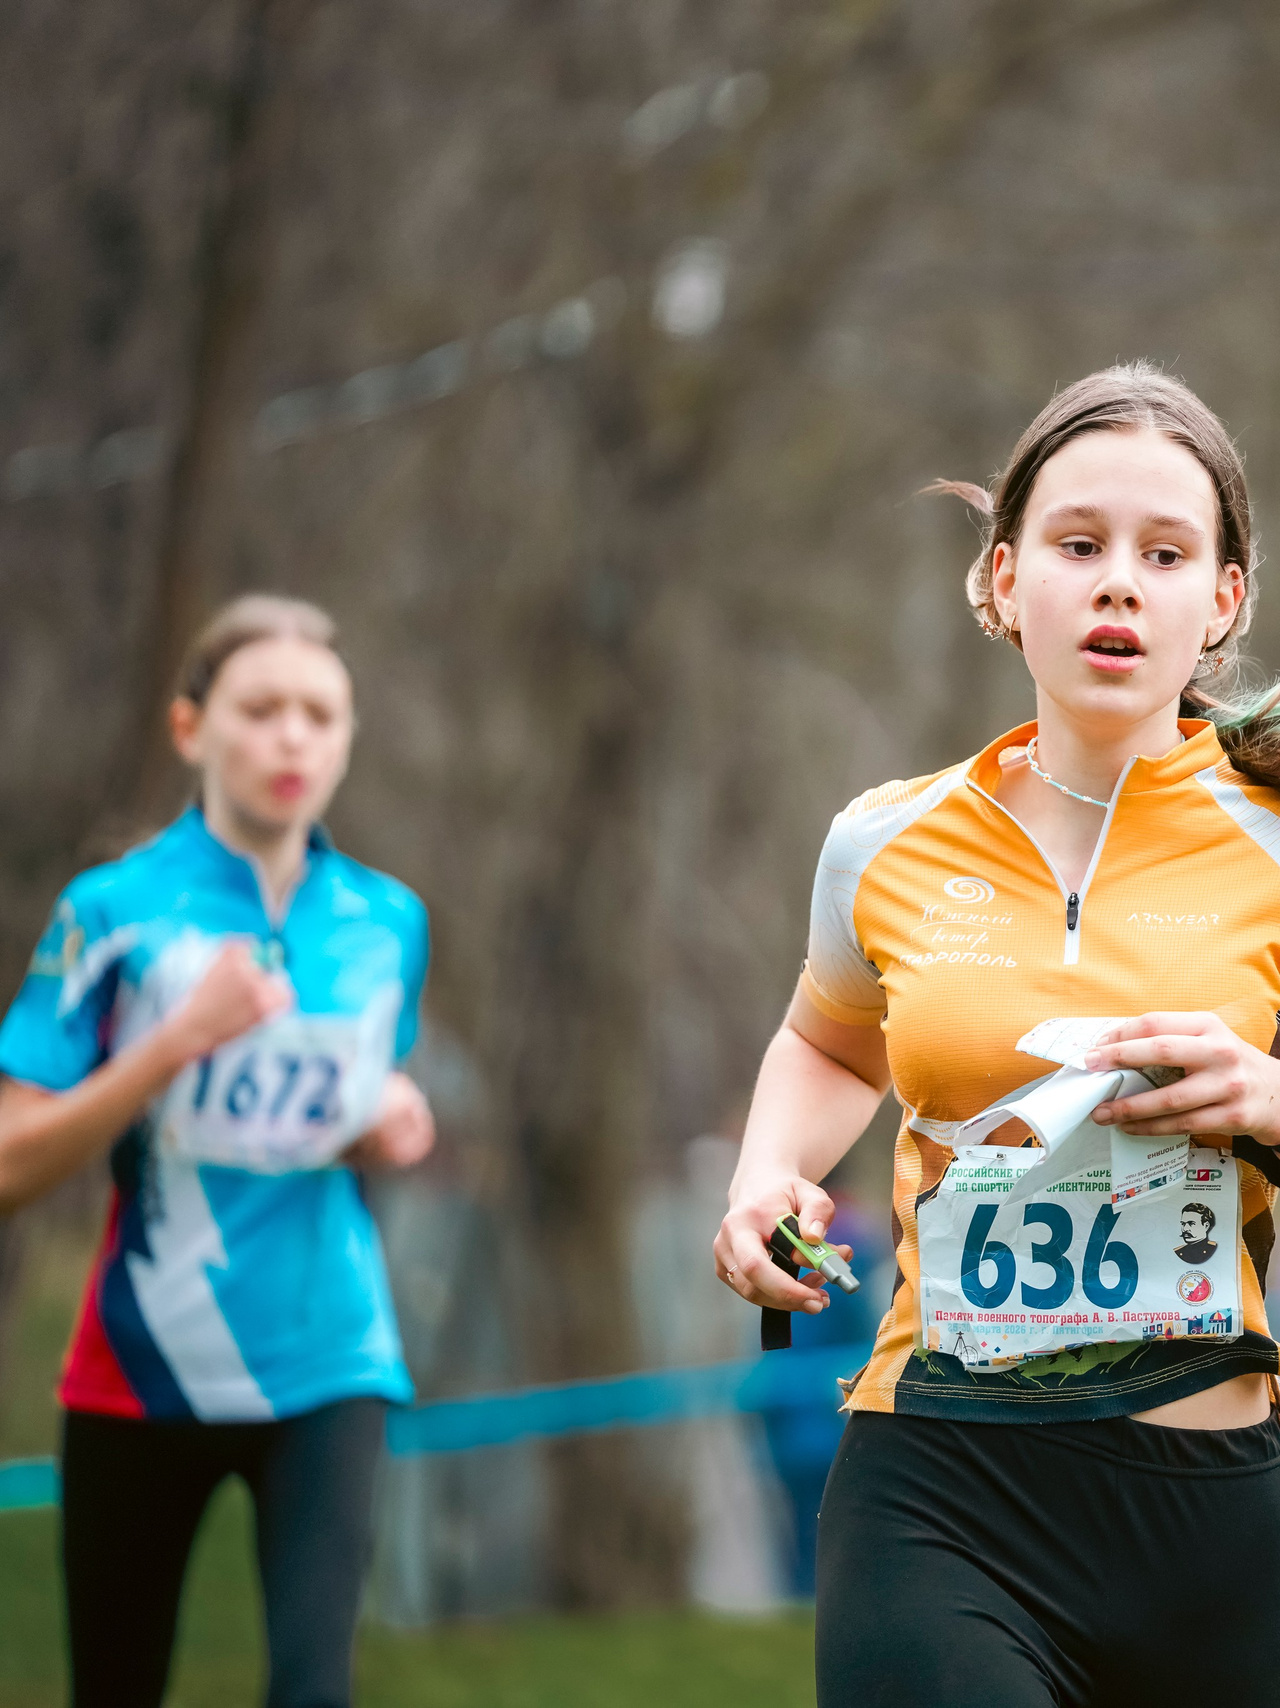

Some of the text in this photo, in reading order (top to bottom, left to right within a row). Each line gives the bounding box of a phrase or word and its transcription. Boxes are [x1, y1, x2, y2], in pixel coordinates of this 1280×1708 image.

[192, 1050, 343, 1125] 1672
[948, 1166, 1012, 1178] РОССИЙСКИЕ
[955, 1182, 968, 1192] ПО
[960, 1202, 1139, 1310] 636
[935, 1310, 974, 1322] Памяти
[977, 1313, 1026, 1324] военного
[1030, 1312, 1089, 1326] топографа
[1123, 1311, 1180, 1324] Пастухова
[973, 1325, 1001, 1335] марта
[1005, 1324, 1026, 1334] 2026
[1052, 1325, 1104, 1336] Пятигорск
